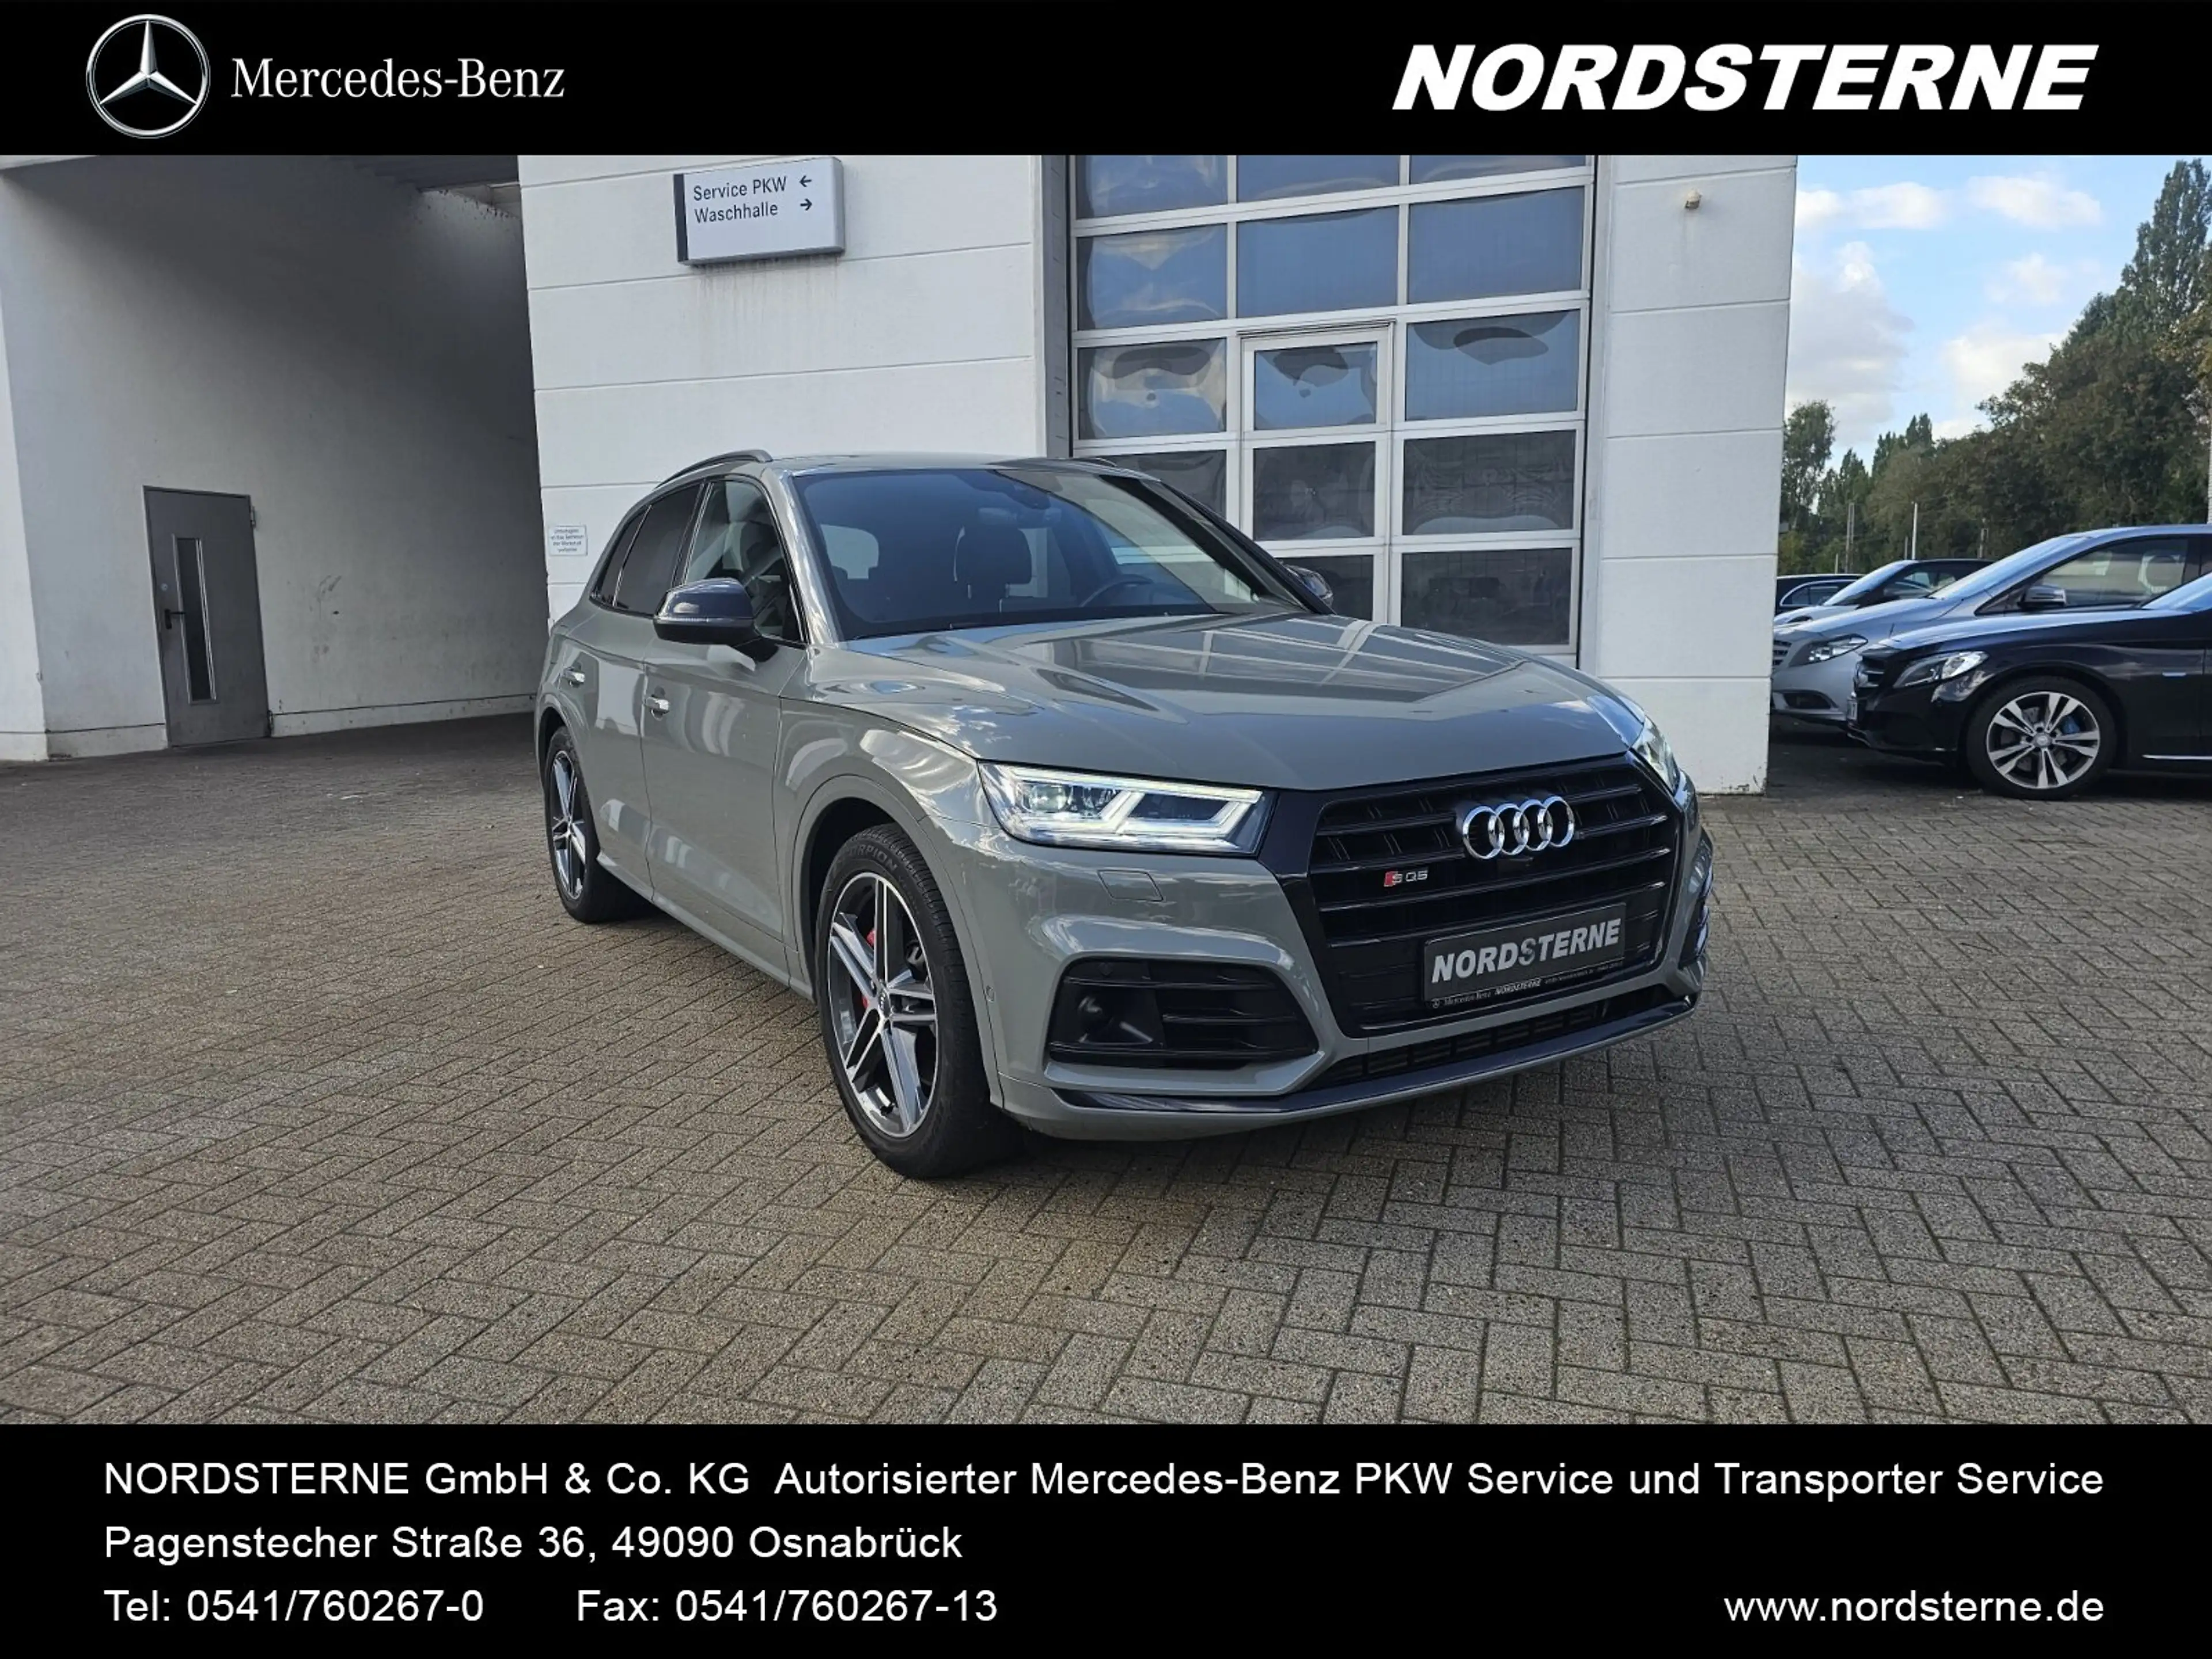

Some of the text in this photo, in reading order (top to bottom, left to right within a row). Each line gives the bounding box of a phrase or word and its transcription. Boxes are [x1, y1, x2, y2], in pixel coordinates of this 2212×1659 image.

[694, 176, 787, 201] Service PKW
[694, 202, 778, 224] Waschhalle
[1431, 918, 1621, 983] NORDSTERNE
